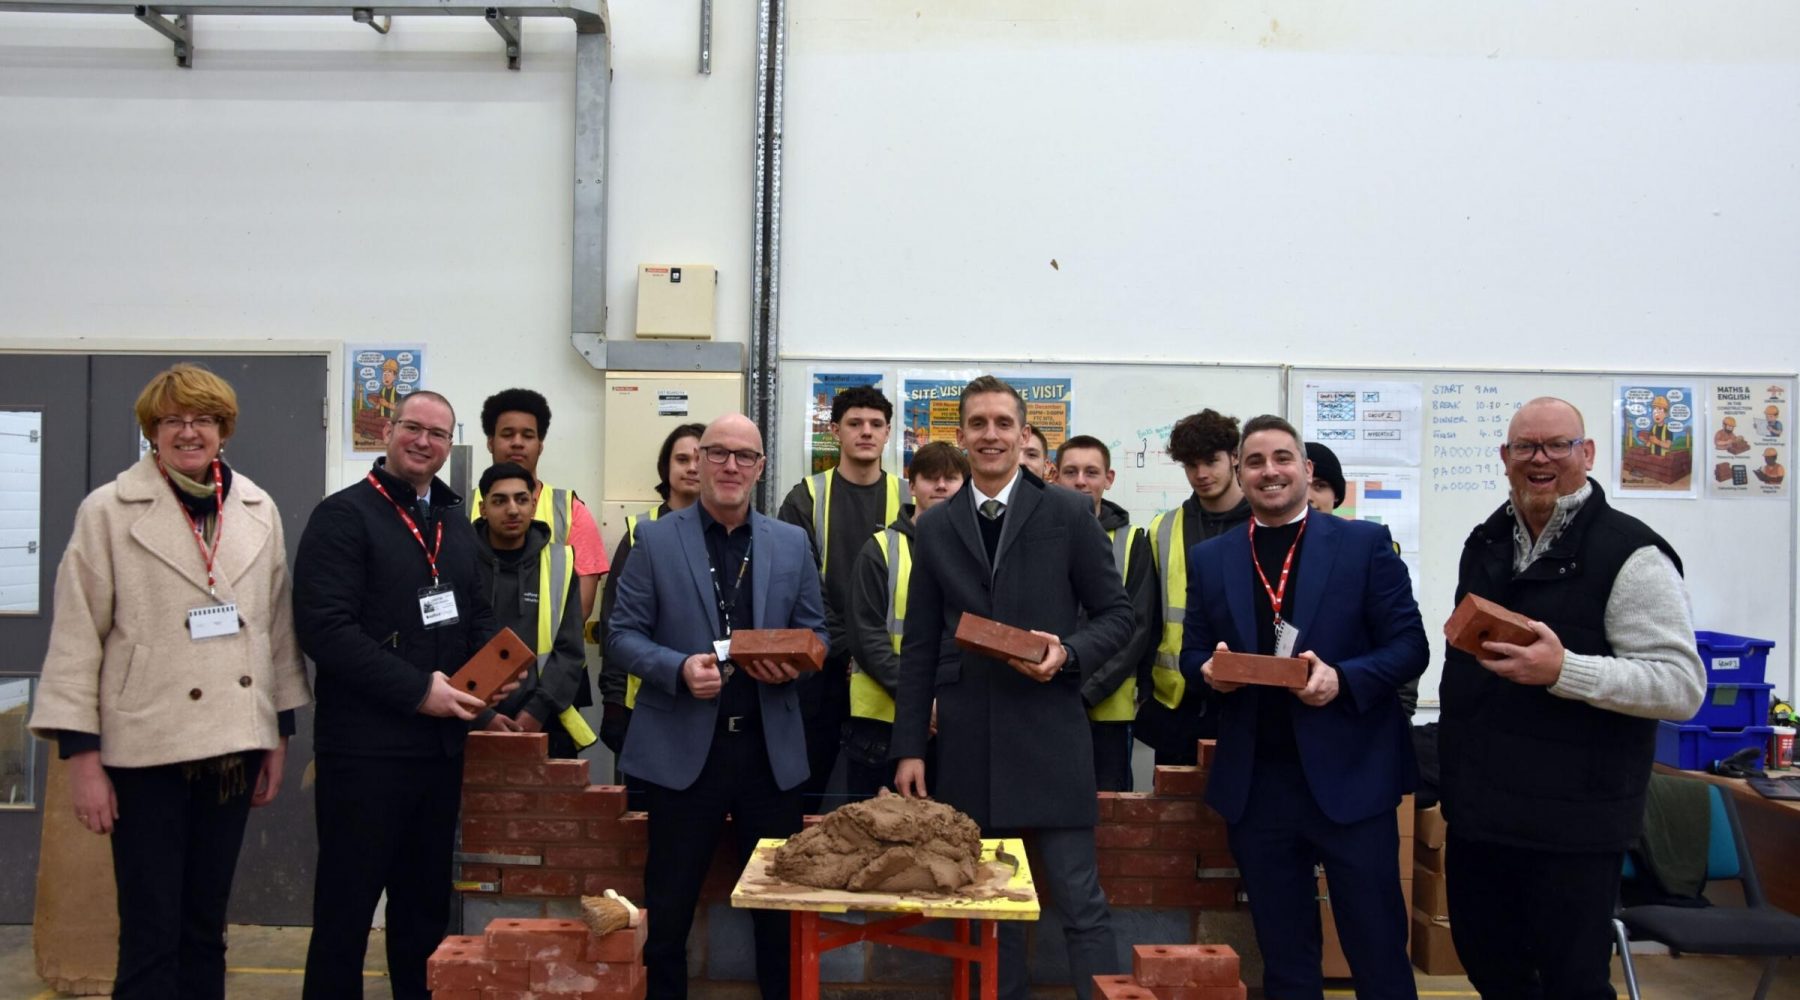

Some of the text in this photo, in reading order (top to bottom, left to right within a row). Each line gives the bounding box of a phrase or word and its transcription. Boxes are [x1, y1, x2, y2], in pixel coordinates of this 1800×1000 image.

[911, 388, 938, 400] SITE
[1032, 384, 1065, 399] VISIT
[1432, 384, 1464, 394] START
